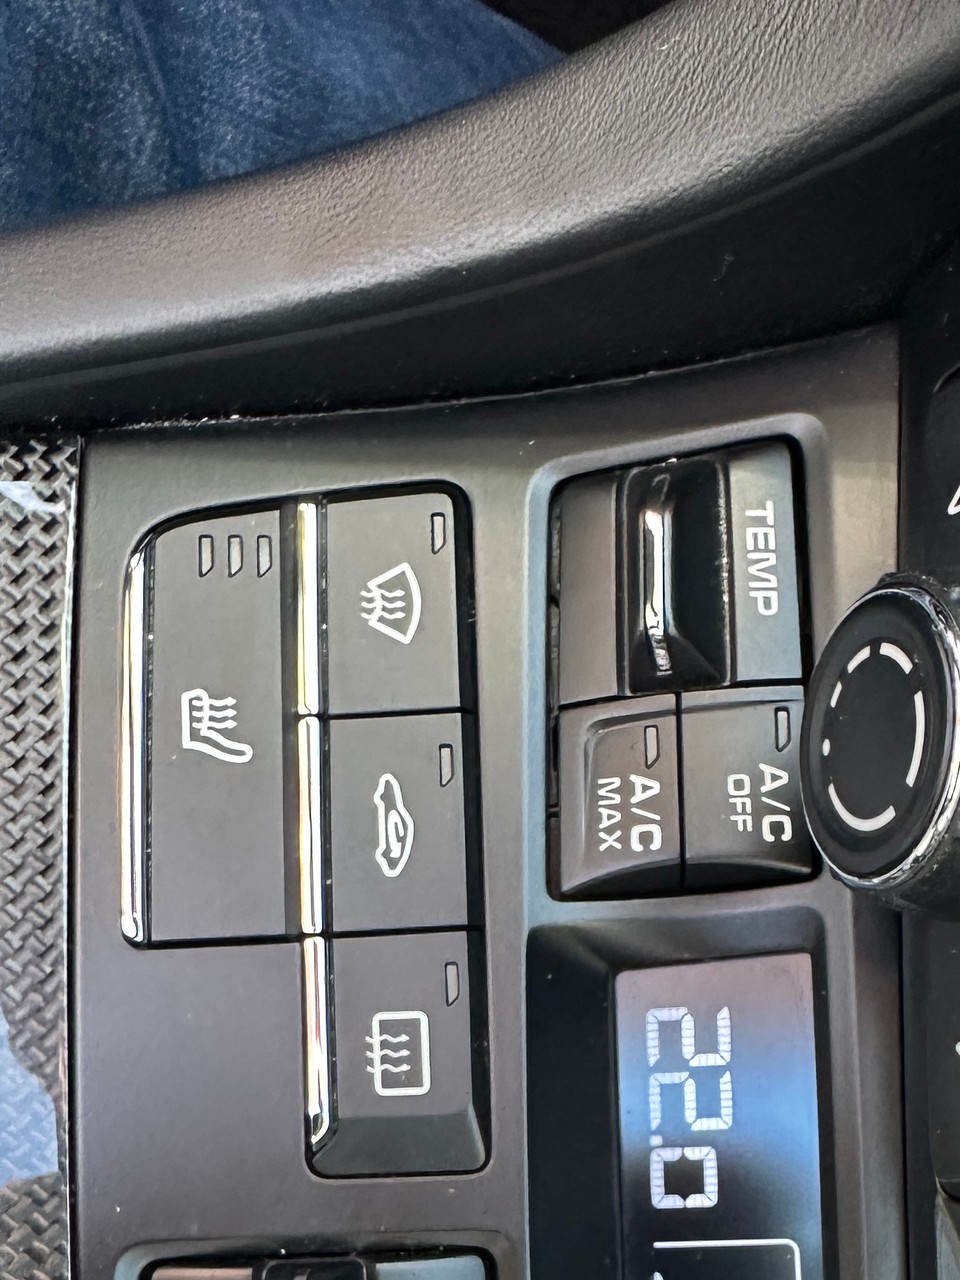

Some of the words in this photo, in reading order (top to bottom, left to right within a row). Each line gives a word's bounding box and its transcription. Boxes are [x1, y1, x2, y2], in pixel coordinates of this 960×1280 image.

[742, 500, 779, 617] TEMP
[596, 776, 623, 853] MAX
[628, 774, 663, 853] A/C
[726, 773, 753, 833] OFF
[758, 762, 793, 843] A/C
[646, 1005, 733, 1210] 22.0
